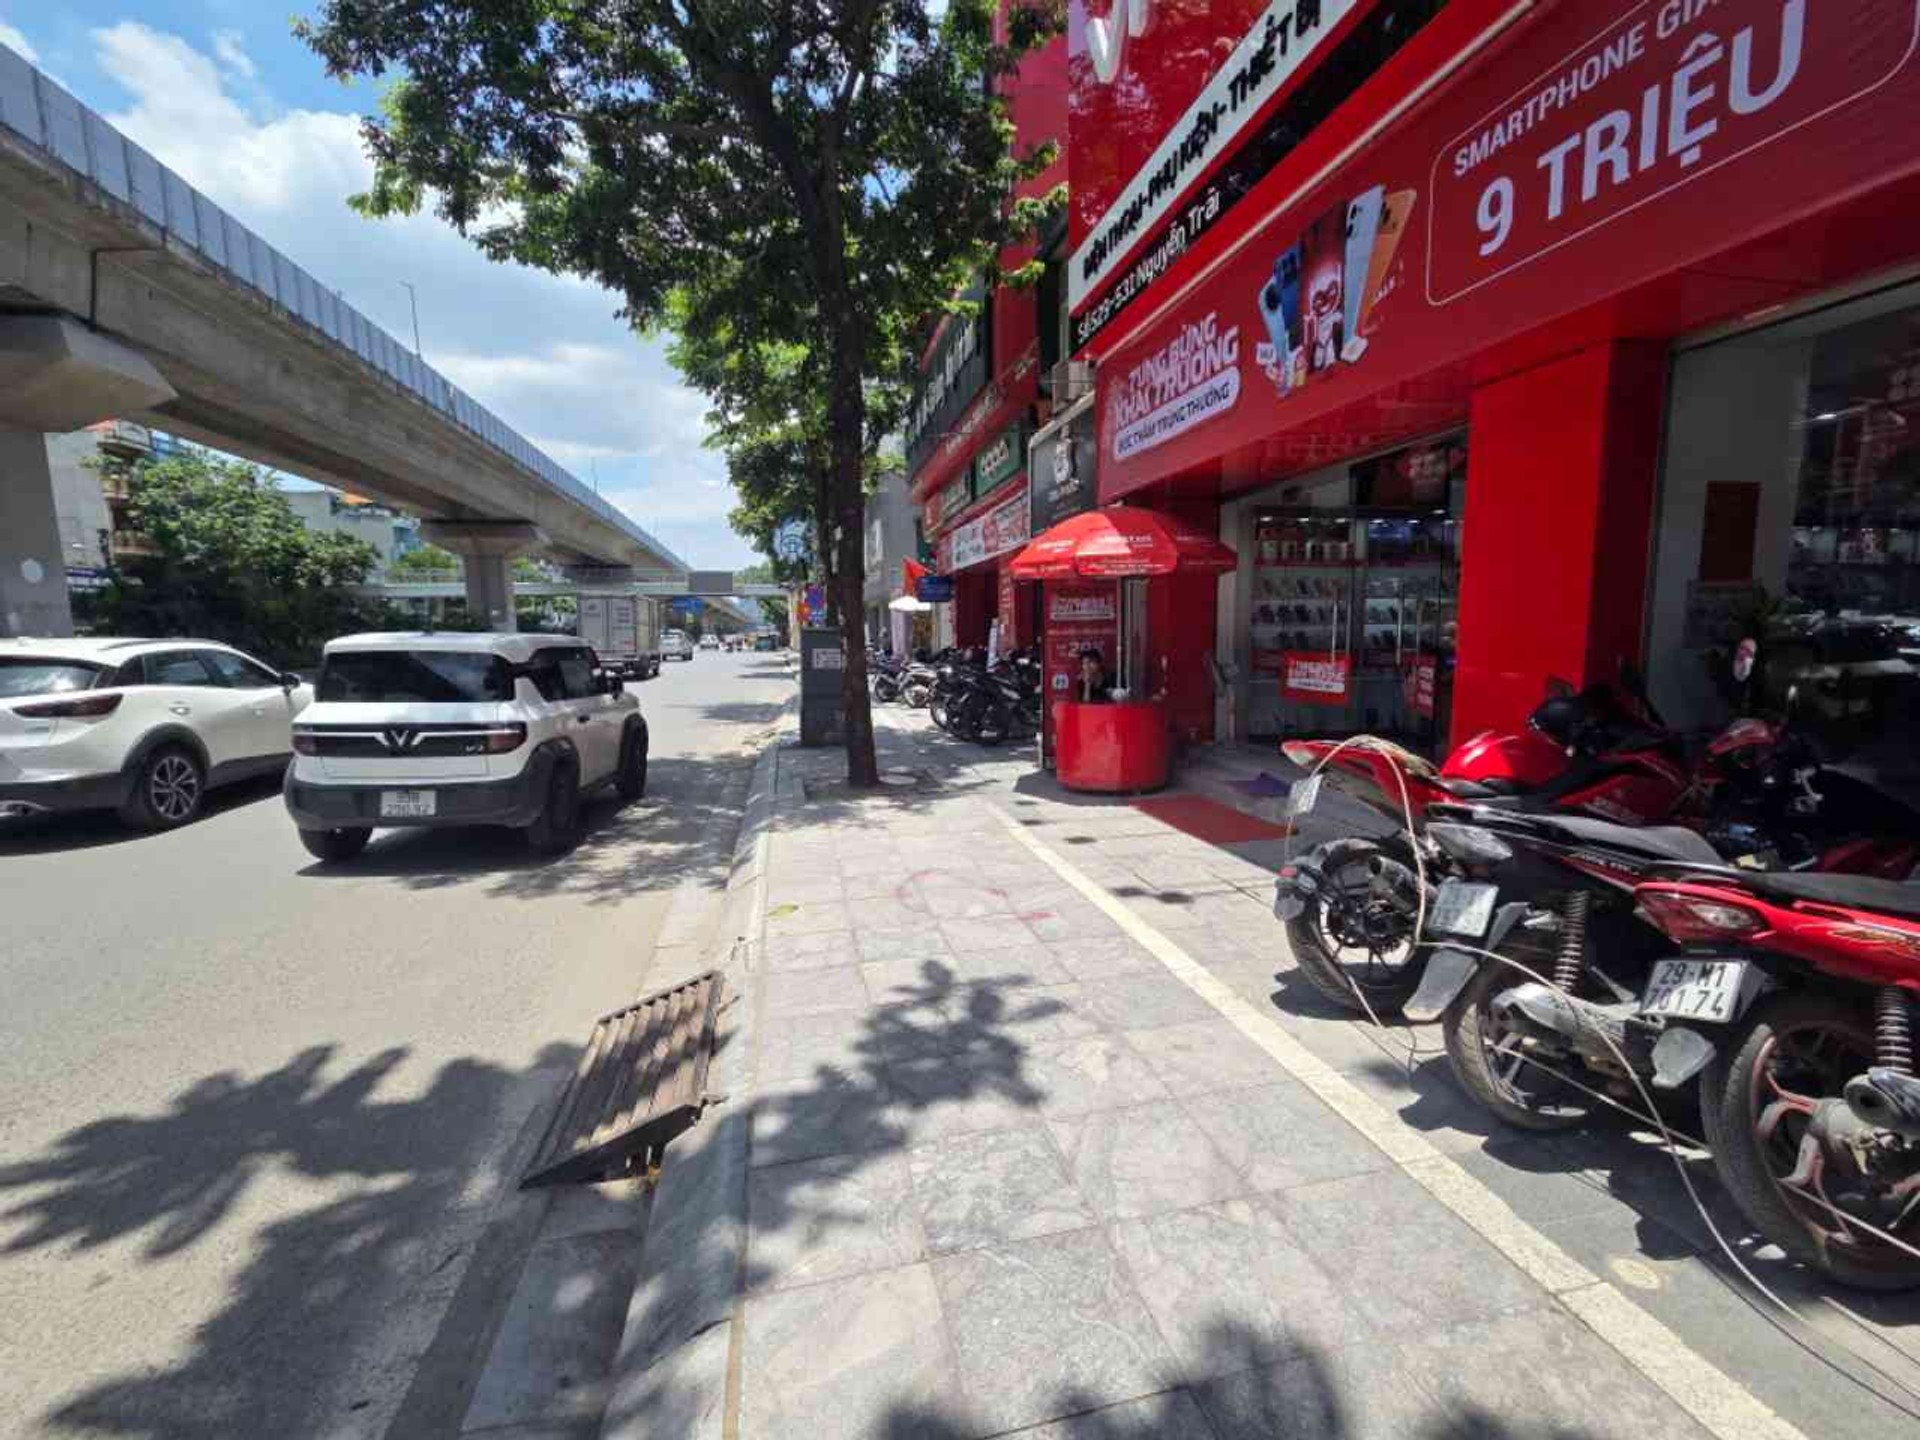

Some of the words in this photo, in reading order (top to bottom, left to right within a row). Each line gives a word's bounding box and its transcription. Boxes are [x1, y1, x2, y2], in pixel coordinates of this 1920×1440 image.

[1454, 20, 1647, 178] SMARTPHONE
[1476, 176, 1514, 257] 9
[1537, 0, 1807, 221] TRIỆU
